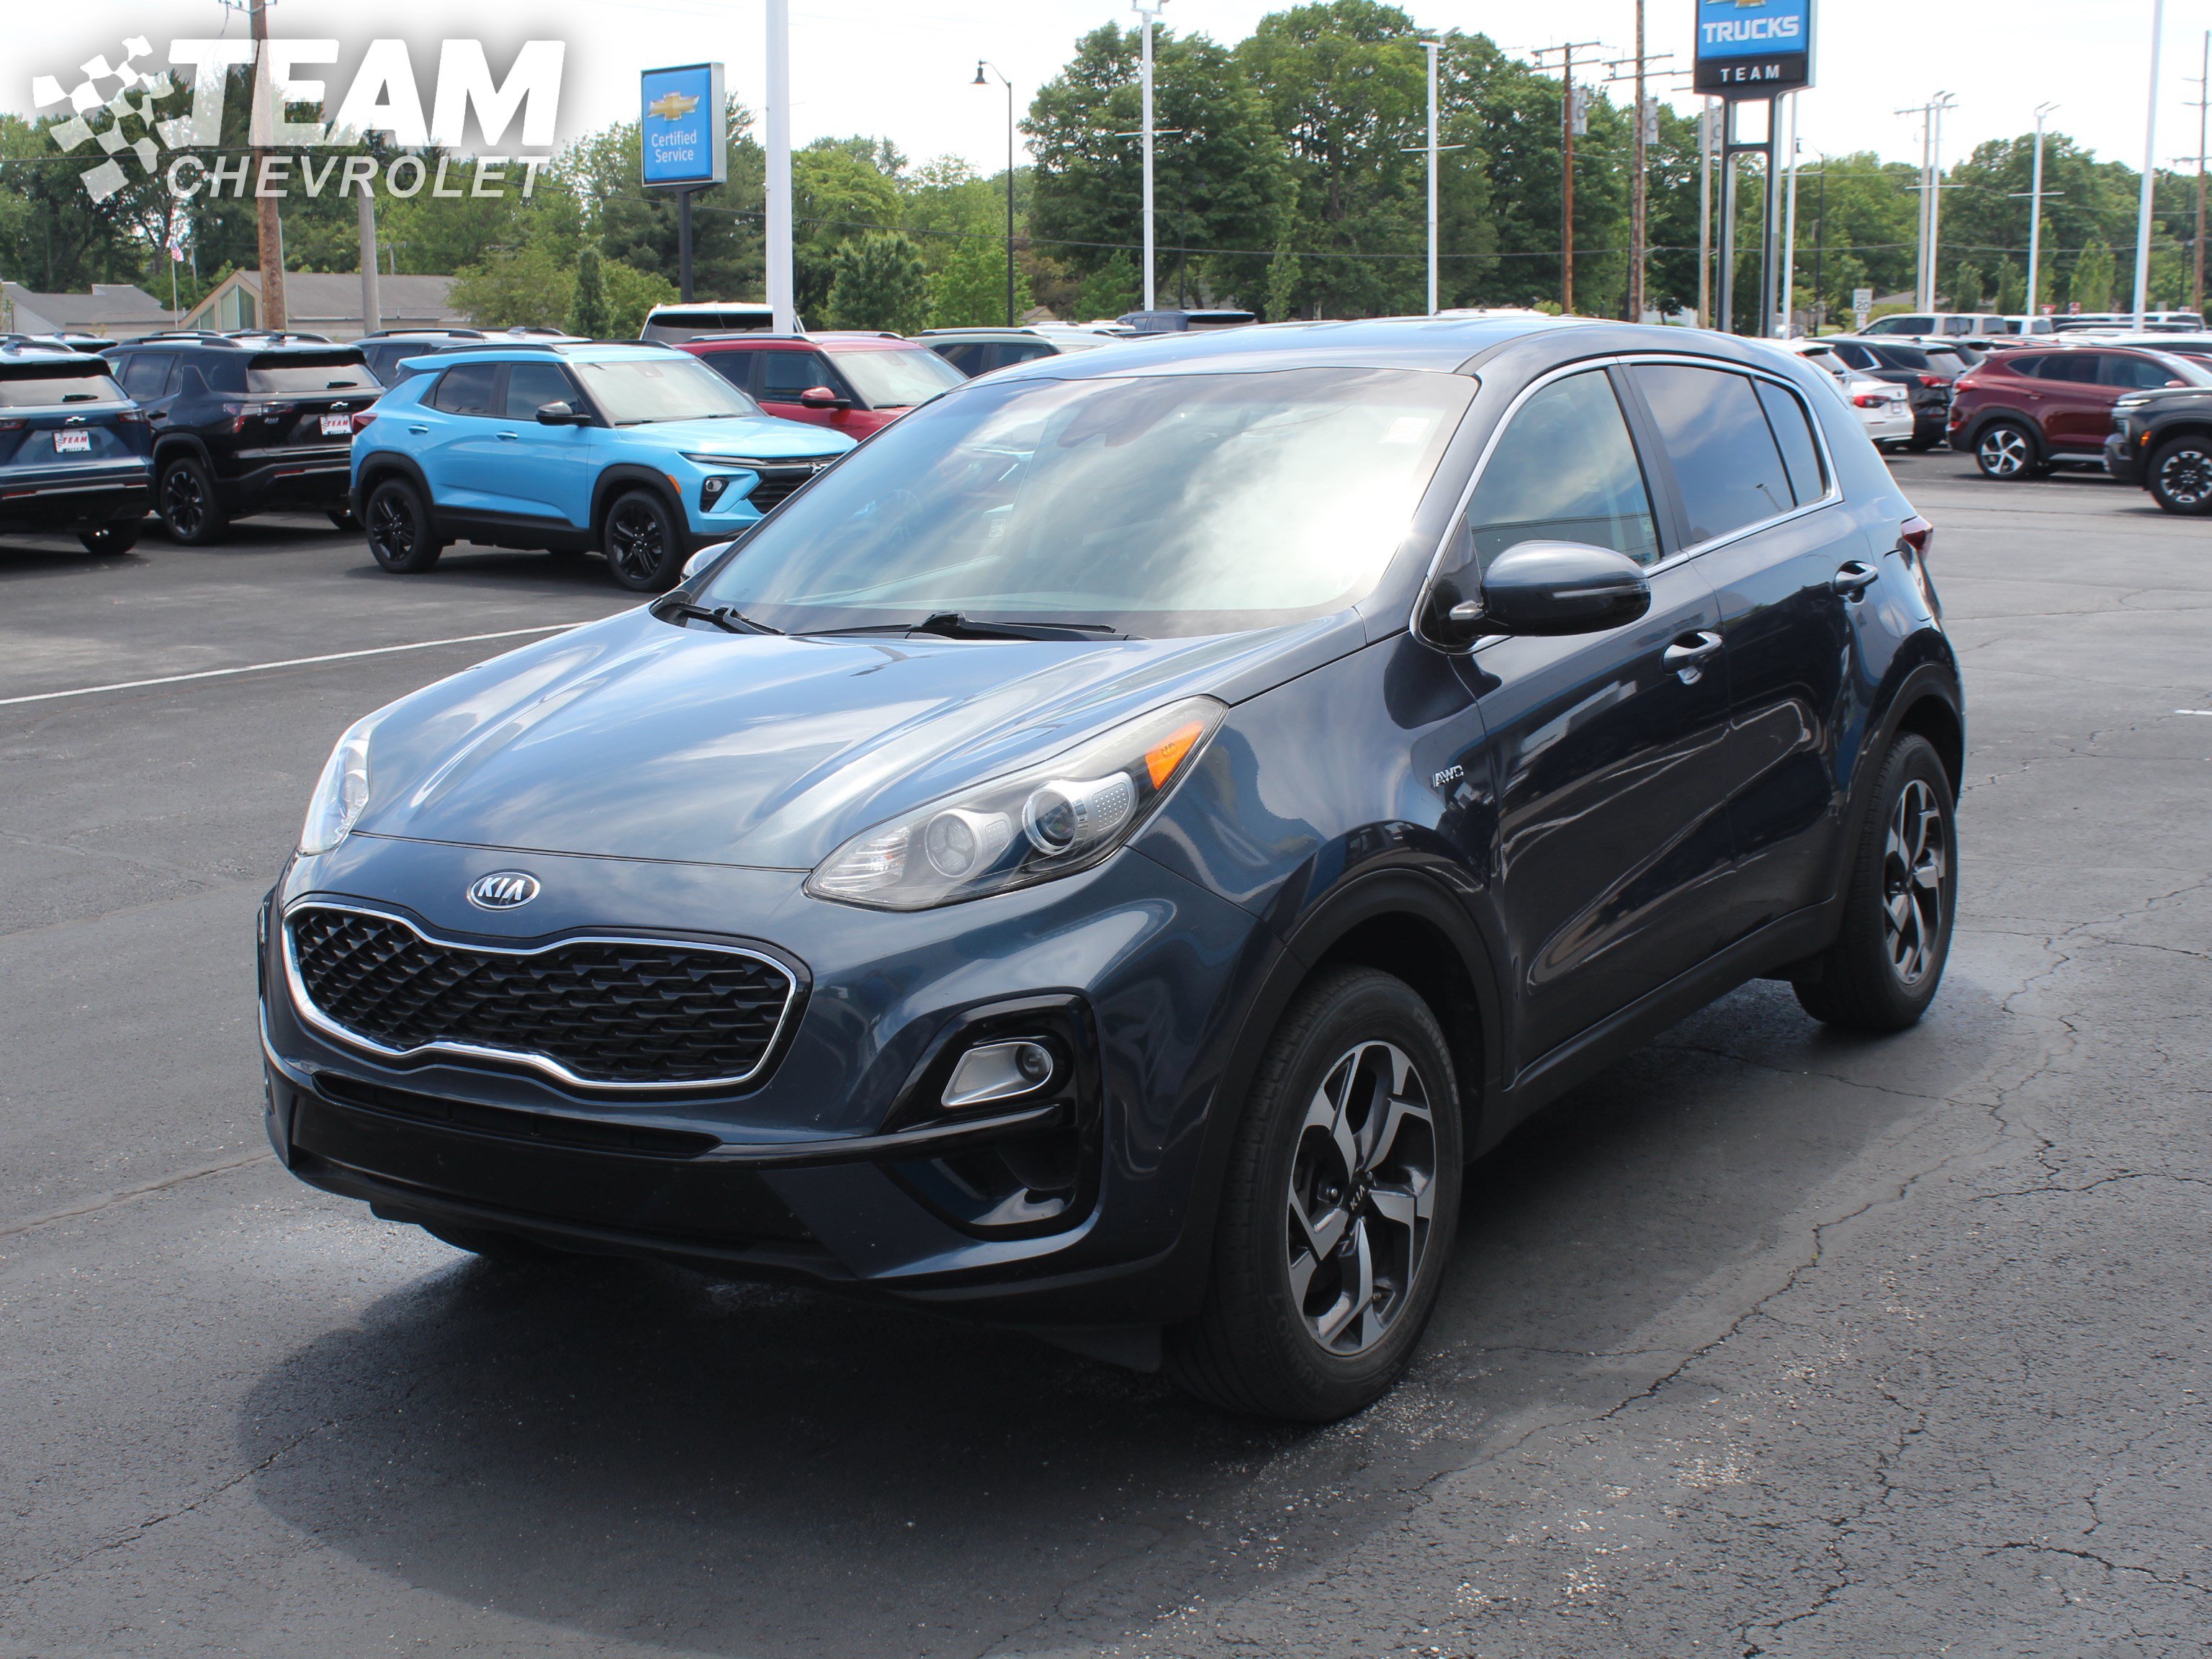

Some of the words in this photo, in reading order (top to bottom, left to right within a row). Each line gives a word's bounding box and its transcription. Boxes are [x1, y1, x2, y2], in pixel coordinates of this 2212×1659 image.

[1702, 15, 1799, 43] TRUCKS
[1720, 64, 1780, 82] TEAM
[651, 130, 697, 147] Certified
[655, 148, 694, 163] Service
[63, 436, 88, 444] TEAM
[1432, 765, 1464, 788] AWD
[477, 877, 526, 900] KIA
[1349, 1184, 1365, 1210] KIA
